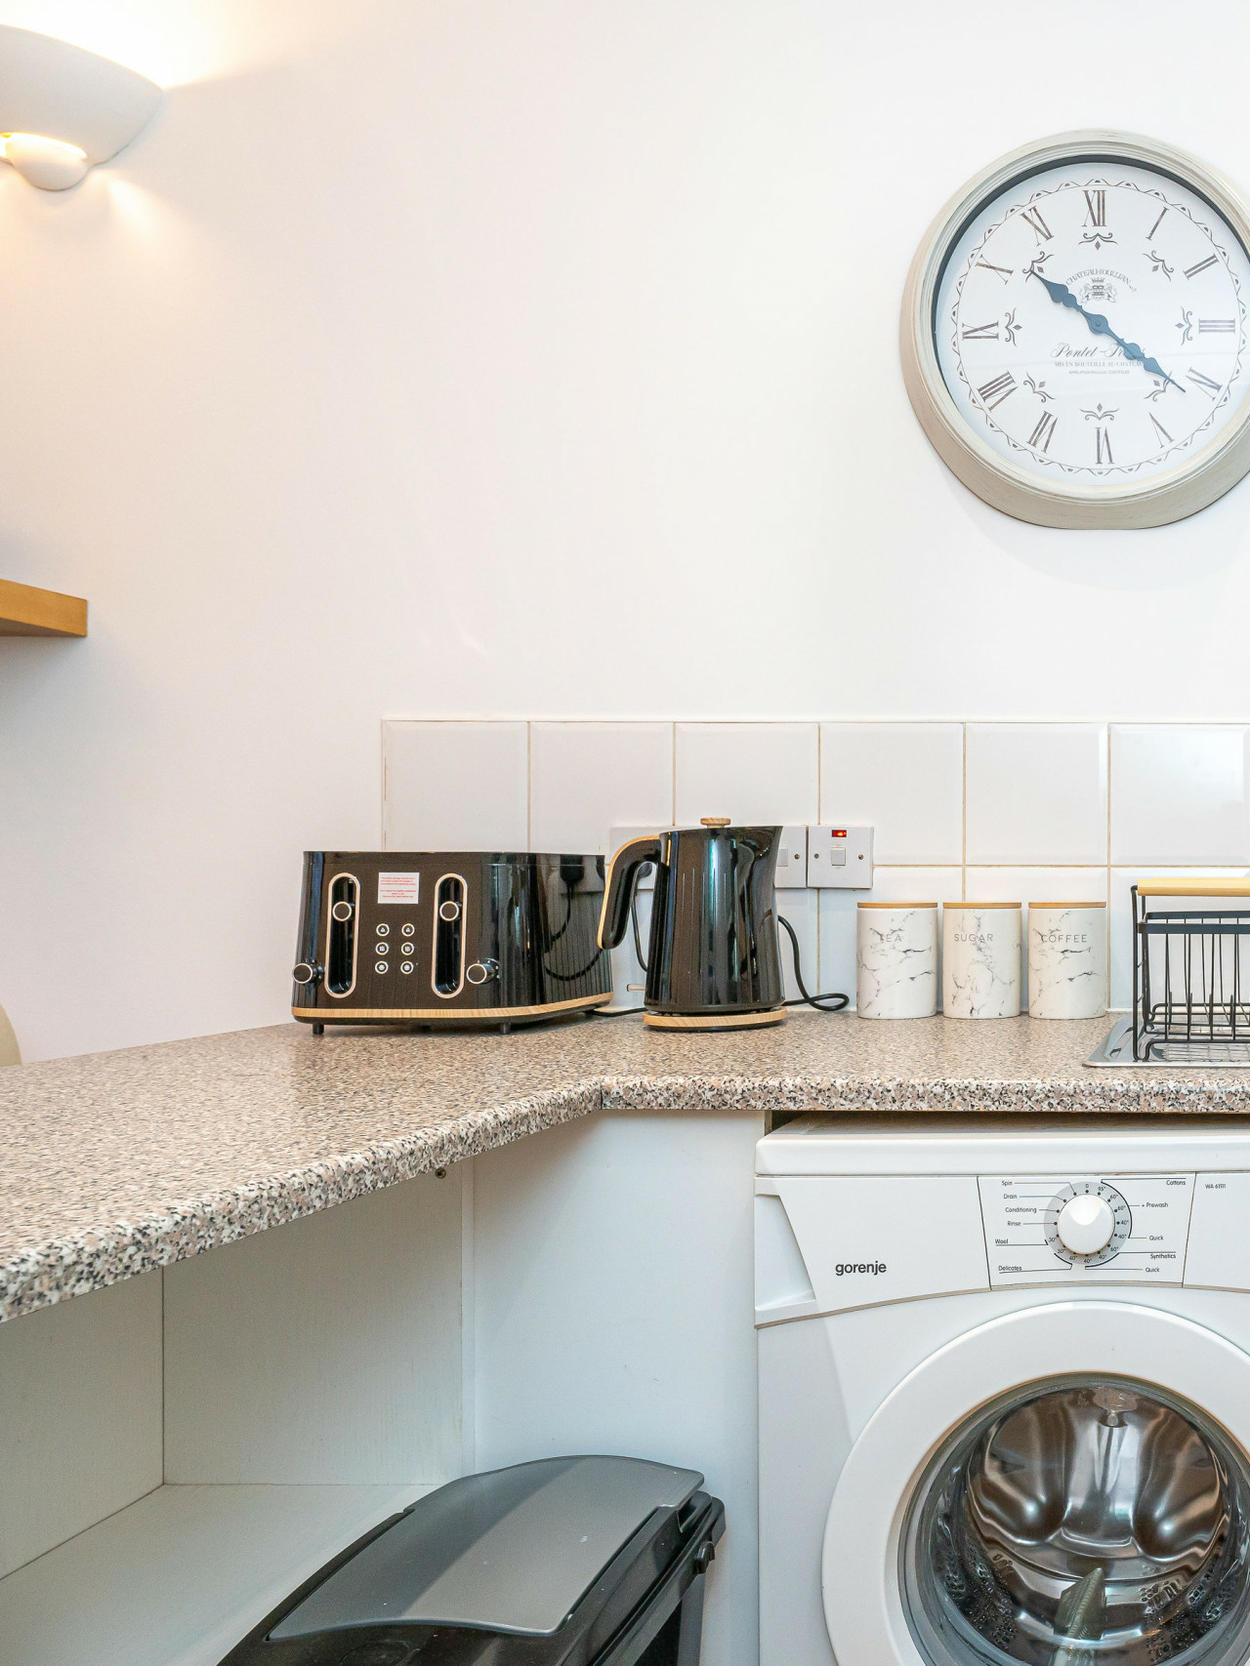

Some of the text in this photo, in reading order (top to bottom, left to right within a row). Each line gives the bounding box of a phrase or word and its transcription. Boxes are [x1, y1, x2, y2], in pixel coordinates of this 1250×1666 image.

[1082, 190, 1108, 228] XII
[953, 933, 994, 943] SUGAR
[1041, 934, 1088, 943] COFFEE
[835, 1260, 887, 1276] gorenje
